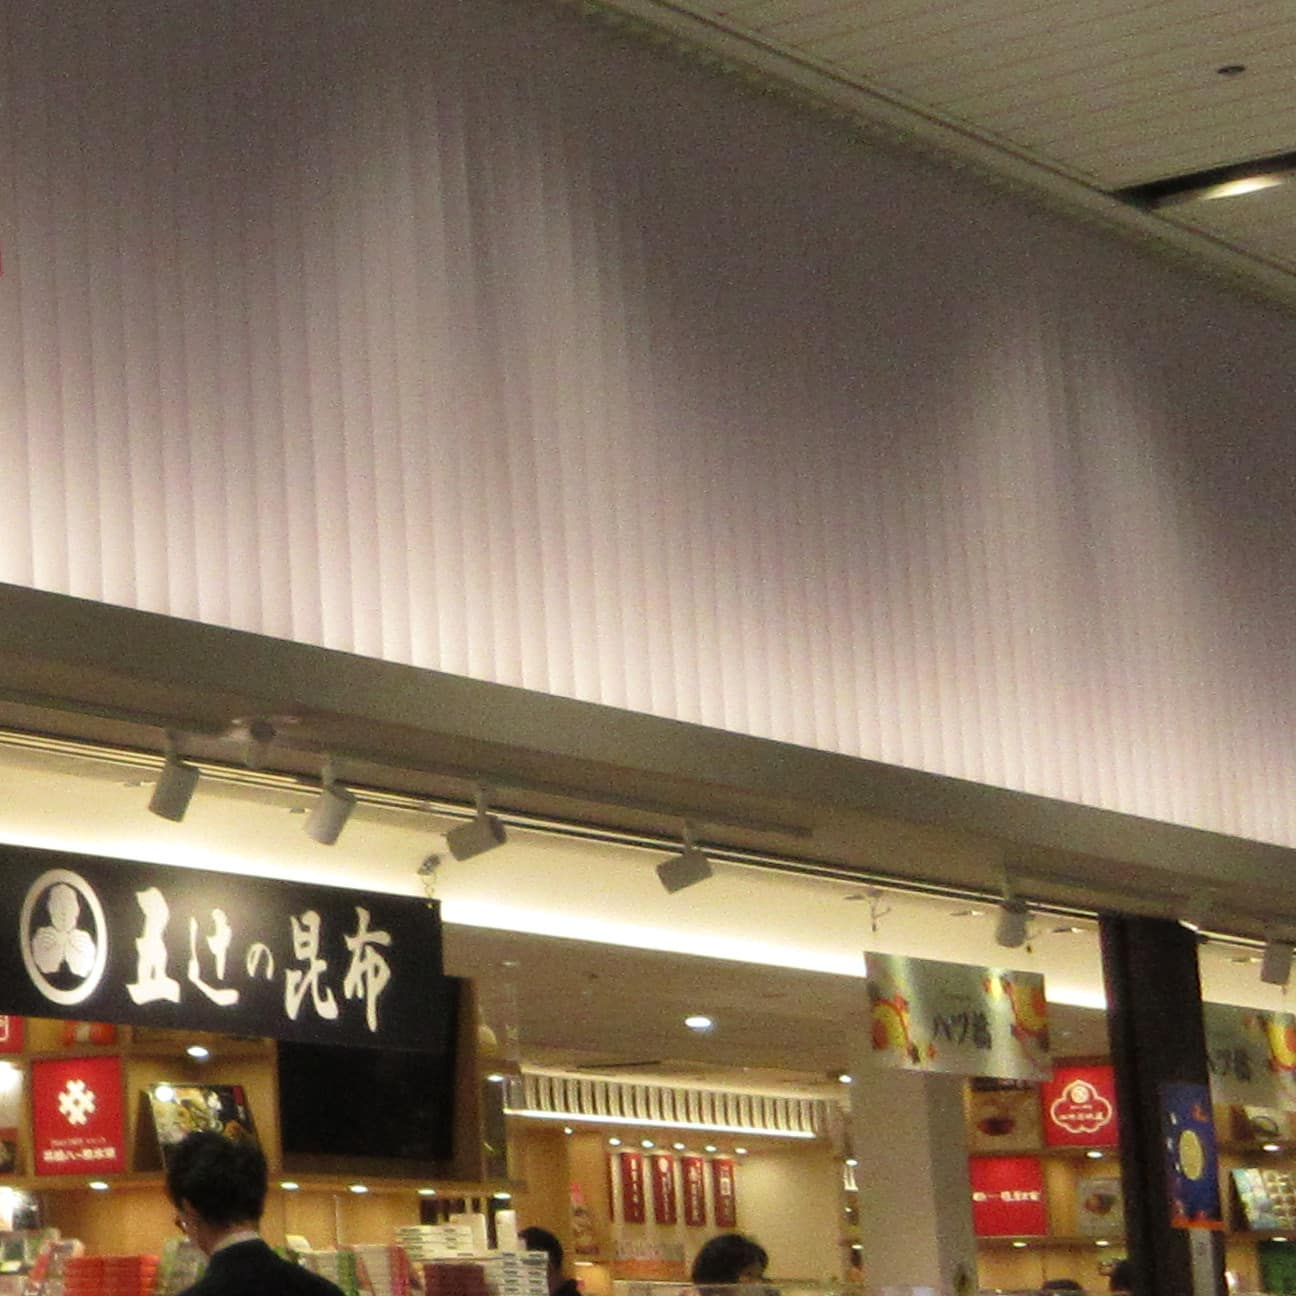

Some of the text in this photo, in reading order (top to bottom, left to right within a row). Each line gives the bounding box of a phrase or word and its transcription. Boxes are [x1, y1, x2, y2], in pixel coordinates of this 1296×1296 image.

[125, 885, 393, 1033] 五辻の昆布
